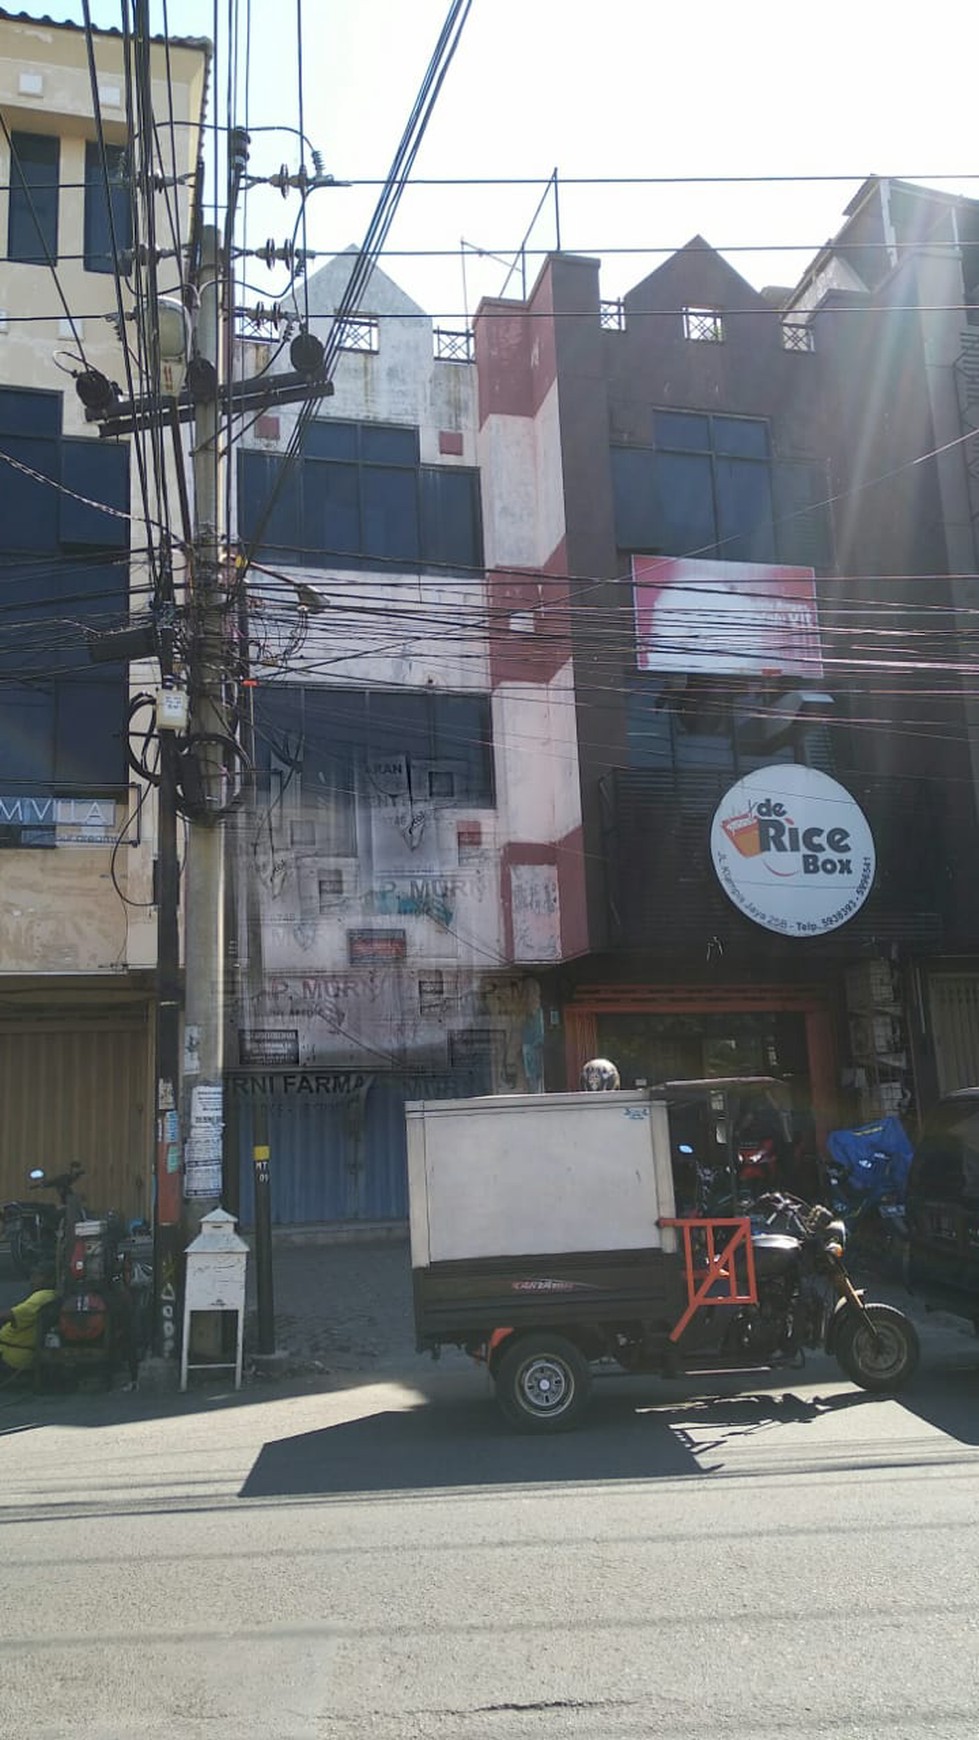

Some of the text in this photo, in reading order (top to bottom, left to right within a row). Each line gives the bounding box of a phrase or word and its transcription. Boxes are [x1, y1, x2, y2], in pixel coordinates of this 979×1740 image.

[757, 798, 787, 817] de
[759, 817, 852, 853] Rice
[803, 854, 853, 875] Box
